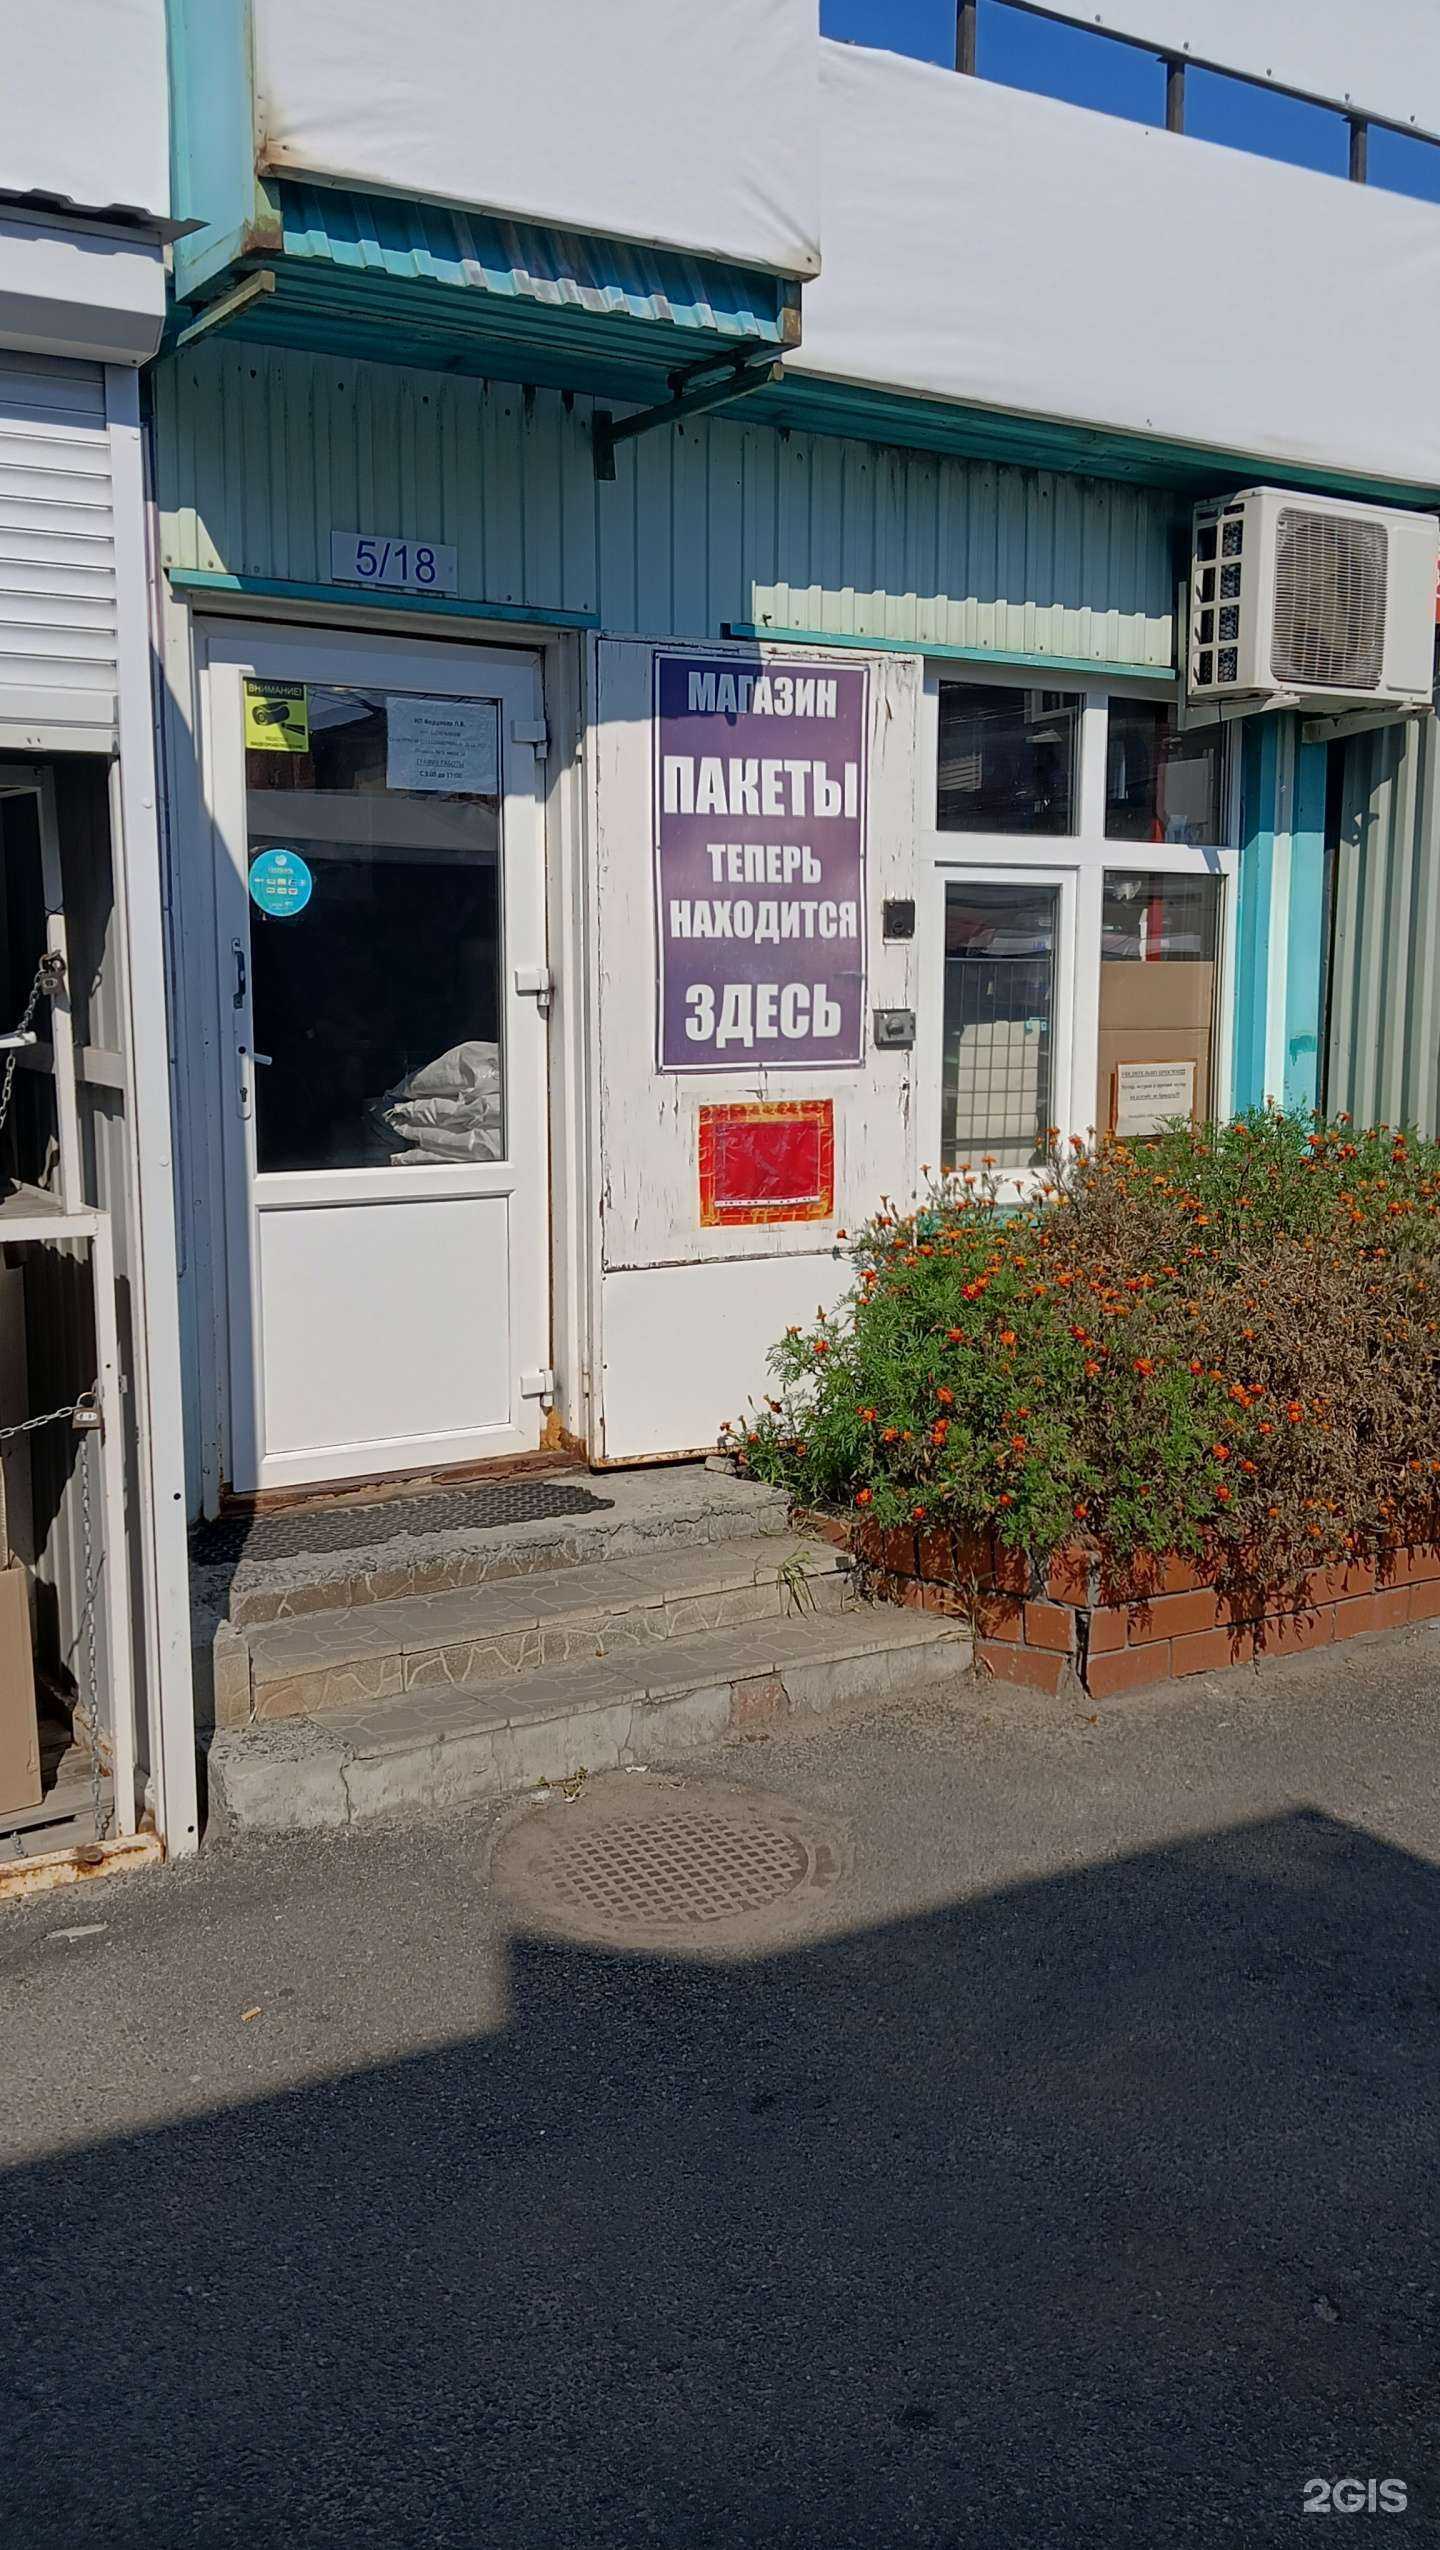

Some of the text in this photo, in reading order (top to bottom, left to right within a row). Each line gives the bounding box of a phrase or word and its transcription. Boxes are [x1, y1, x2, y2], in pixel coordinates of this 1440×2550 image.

[356, 540, 436, 583] 5/18
[688, 671, 837, 718] МАГАЗИН
[663, 755, 858, 818] ПАКЕТЫ
[706, 844, 822, 884] ТЕПЕРЬ
[670, 900, 858, 944] НАХОДИТСЯ
[685, 983, 842, 1048] ЗДЕСЬ
